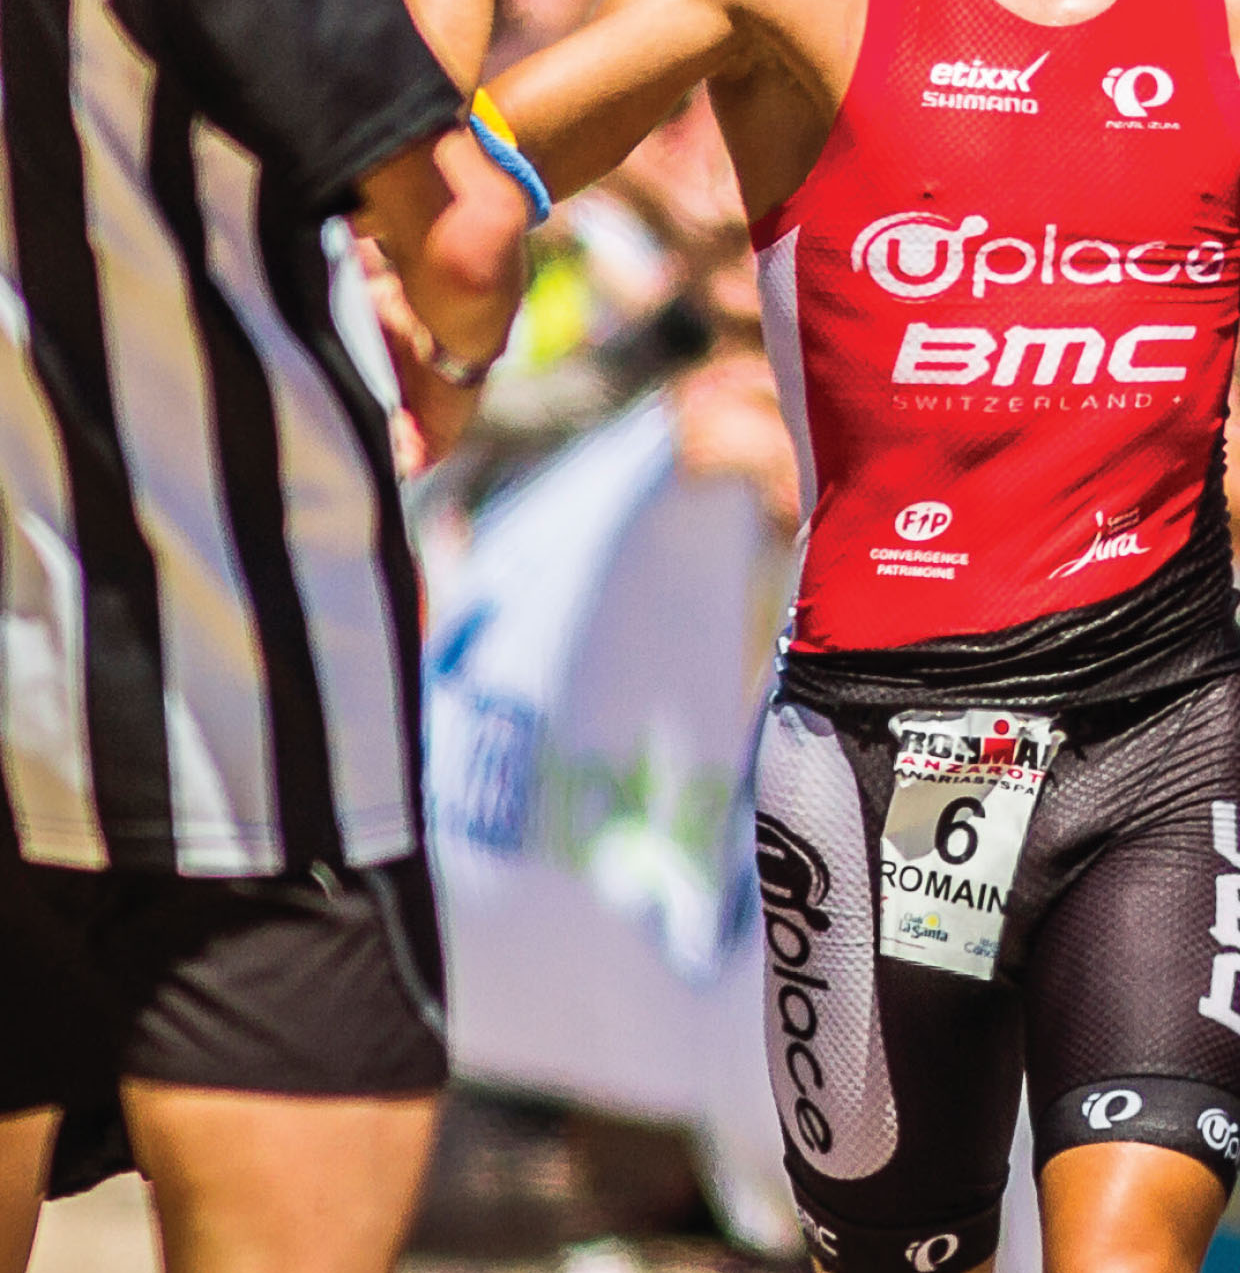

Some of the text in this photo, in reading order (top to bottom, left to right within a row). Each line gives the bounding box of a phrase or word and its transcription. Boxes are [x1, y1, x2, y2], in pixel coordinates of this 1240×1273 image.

[921, 90, 1038, 115] SHIMANO
[891, 323, 1196, 386] BMC
[892, 393, 1153, 412] SWITZERLAND
[870, 548, 969, 566] CONVERGENCE
[877, 563, 955, 579] PATRIMOINE
[934, 796, 986, 865] 6
